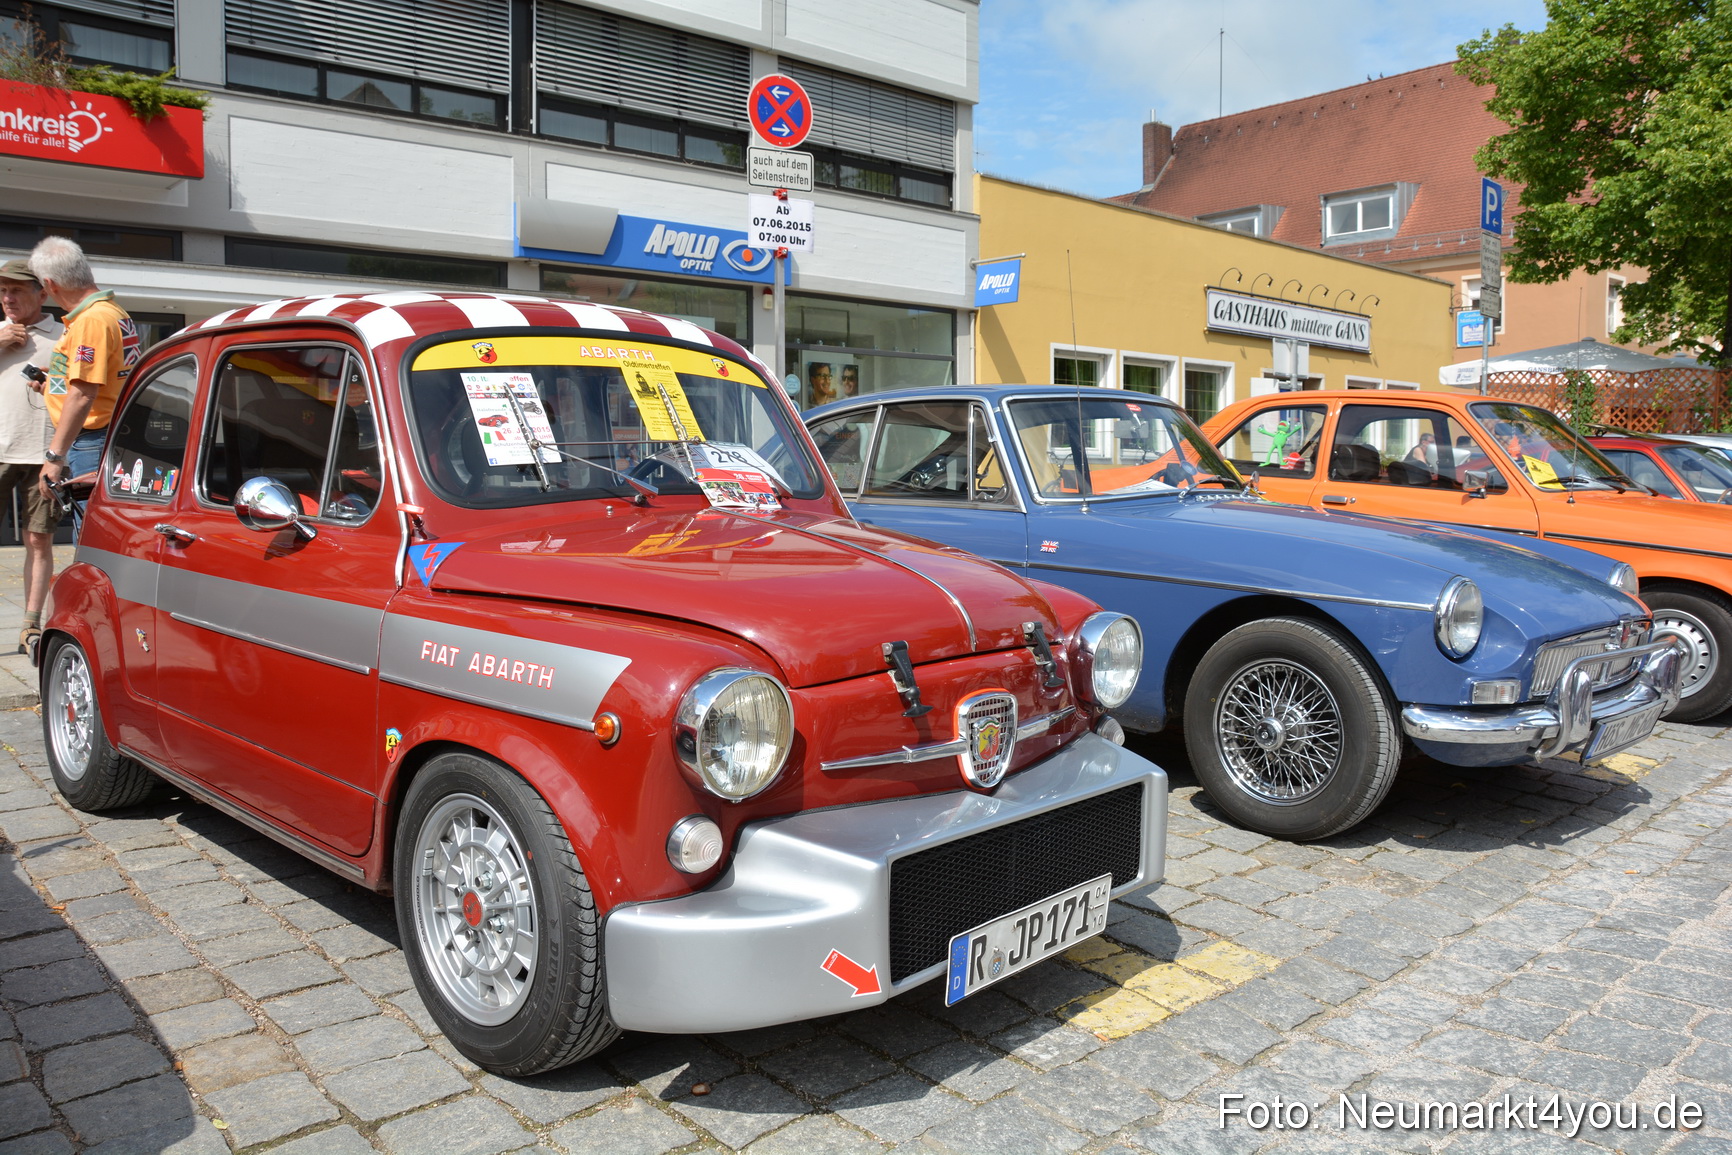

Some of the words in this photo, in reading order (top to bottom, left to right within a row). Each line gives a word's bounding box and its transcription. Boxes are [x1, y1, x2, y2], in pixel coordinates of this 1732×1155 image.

[23, 133, 40, 145] für
[42, 138, 65, 148] alle!
[753, 155, 773, 167] auch
[776, 158, 790, 168] auf
[792, 159, 808, 171] dem
[752, 169, 809, 186] Seitenstreifen
[776, 205, 790, 216] Ab
[1485, 185, 1498, 225] P
[753, 217, 811, 232] 07.06.2015
[644, 223, 720, 260] APOLLO
[758, 232, 787, 244] 07:00
[789, 234, 806, 246] Uhr
[680, 258, 714, 272] OPTIK
[978, 272, 1016, 291] APOLLO
[994, 287, 1010, 295] OPTIK
[1213, 299, 1288, 330] GASTHAUS
[1290, 317, 1332, 338] mittlere
[1335, 320, 1366, 342] GANS
[580, 345, 656, 361] ABARTH
[623, 360, 671, 371] Oldtimertreffen
[420, 639, 460, 668] FIAT
[468, 652, 555, 690] ABARTH
[1095, 883, 1107, 900] 04
[952, 975, 961, 991] D
[968, 934, 988, 987] R
[1009, 890, 1091, 967] JP171
